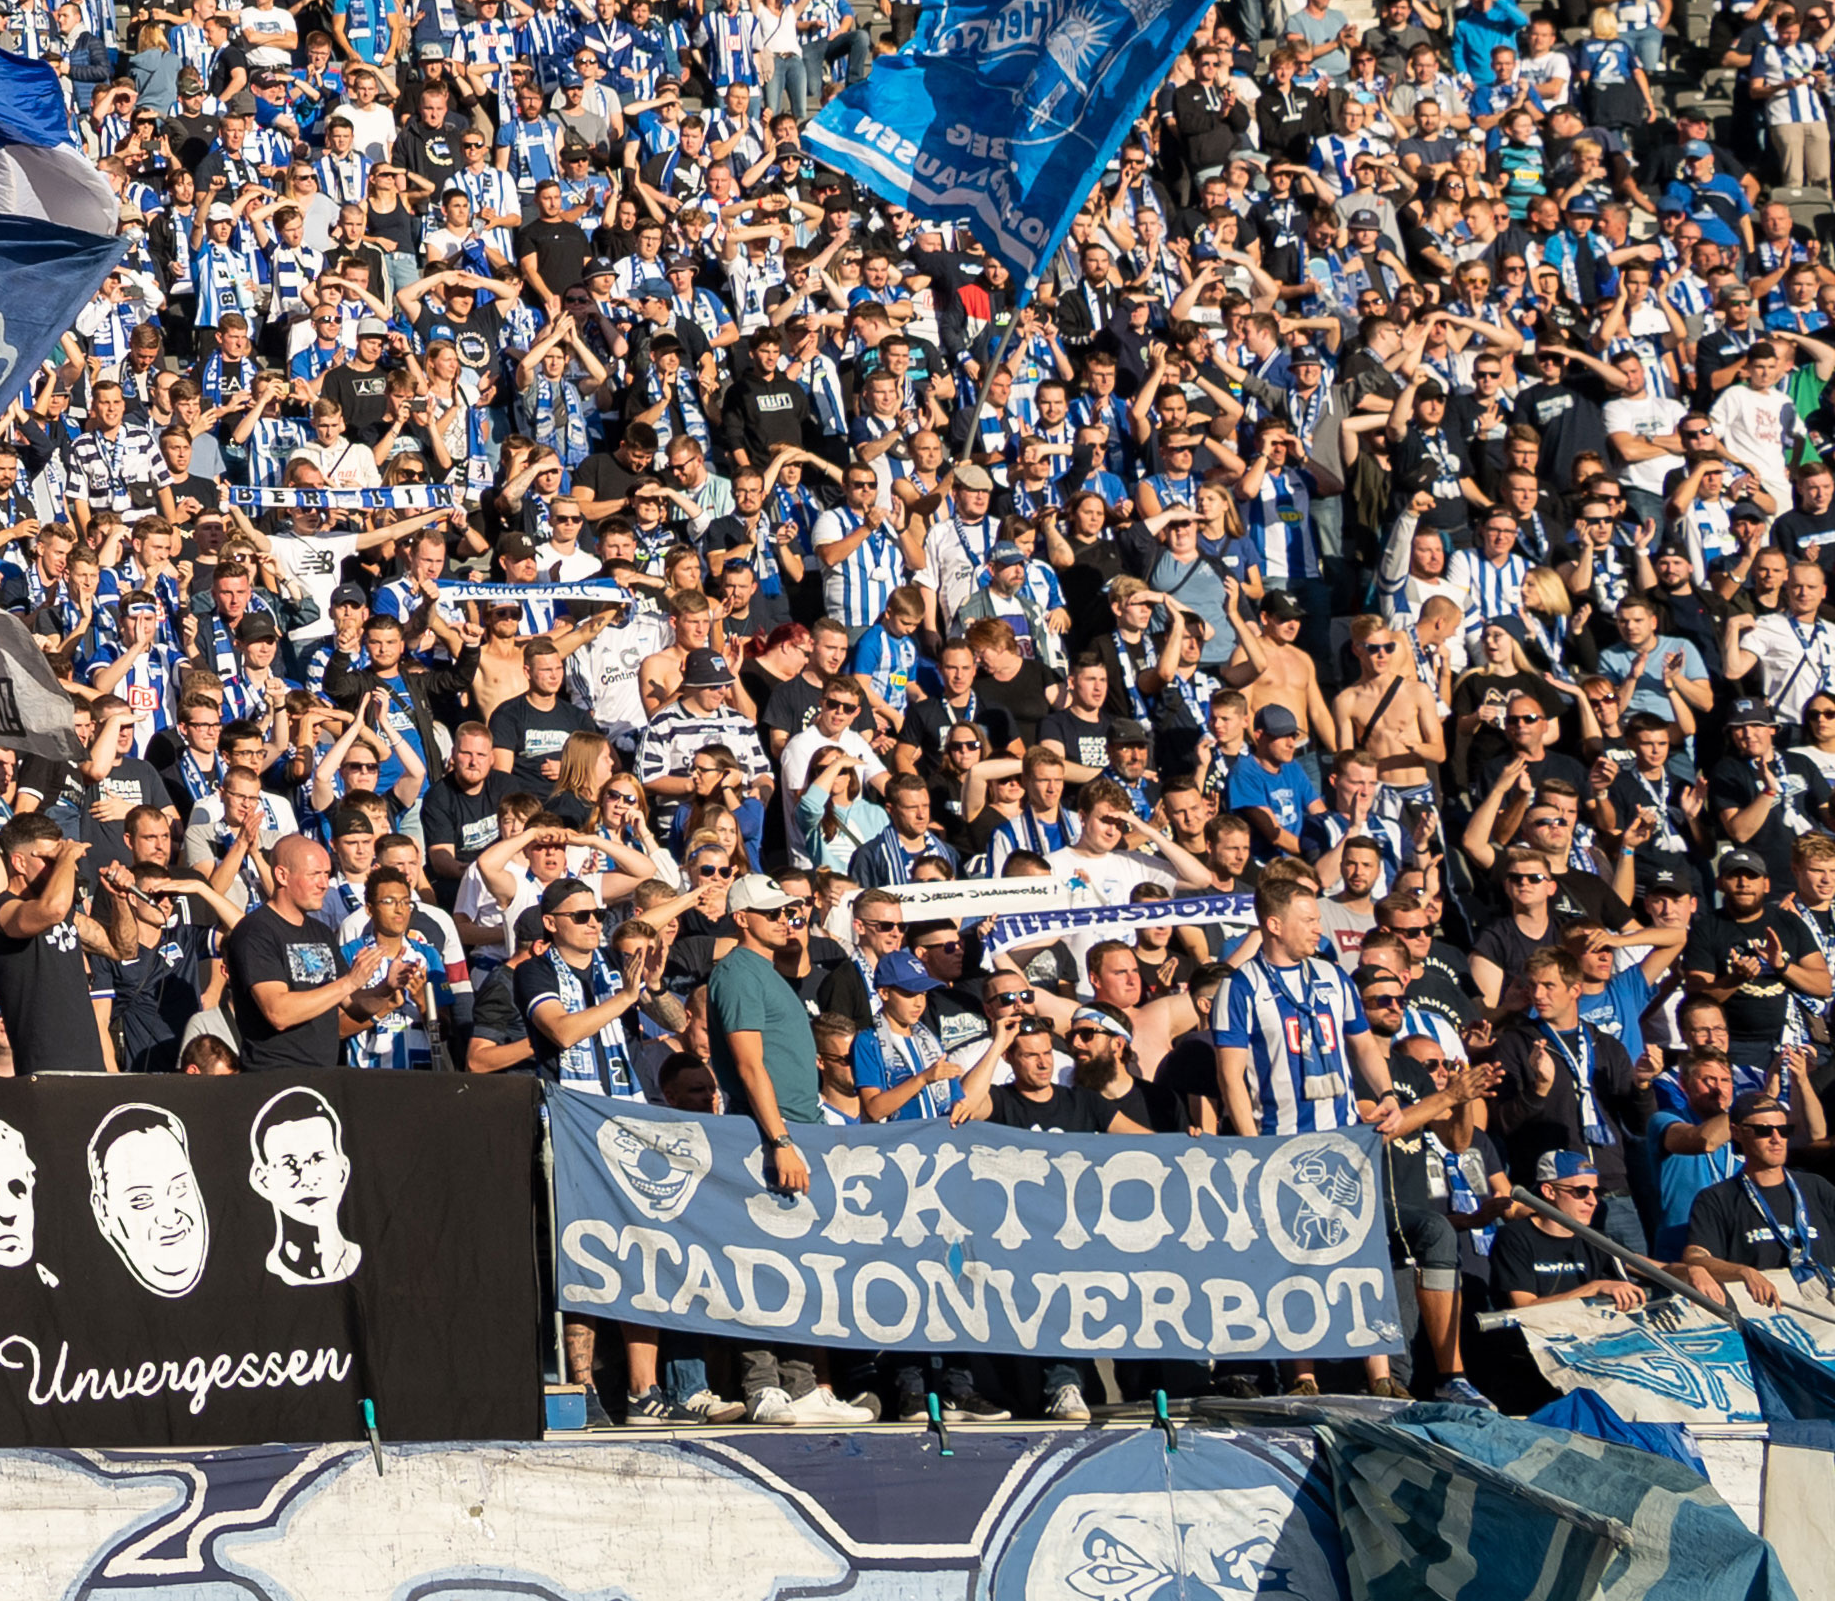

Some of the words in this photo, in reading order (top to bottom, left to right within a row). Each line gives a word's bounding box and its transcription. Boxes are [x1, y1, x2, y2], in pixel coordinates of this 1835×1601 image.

[236, 486, 453, 508] BERLIN
[131, 687, 154, 707] DB
[745, 1142, 1261, 1252] SEKTION
[562, 1219, 1385, 1355] STADIONVERBOT
